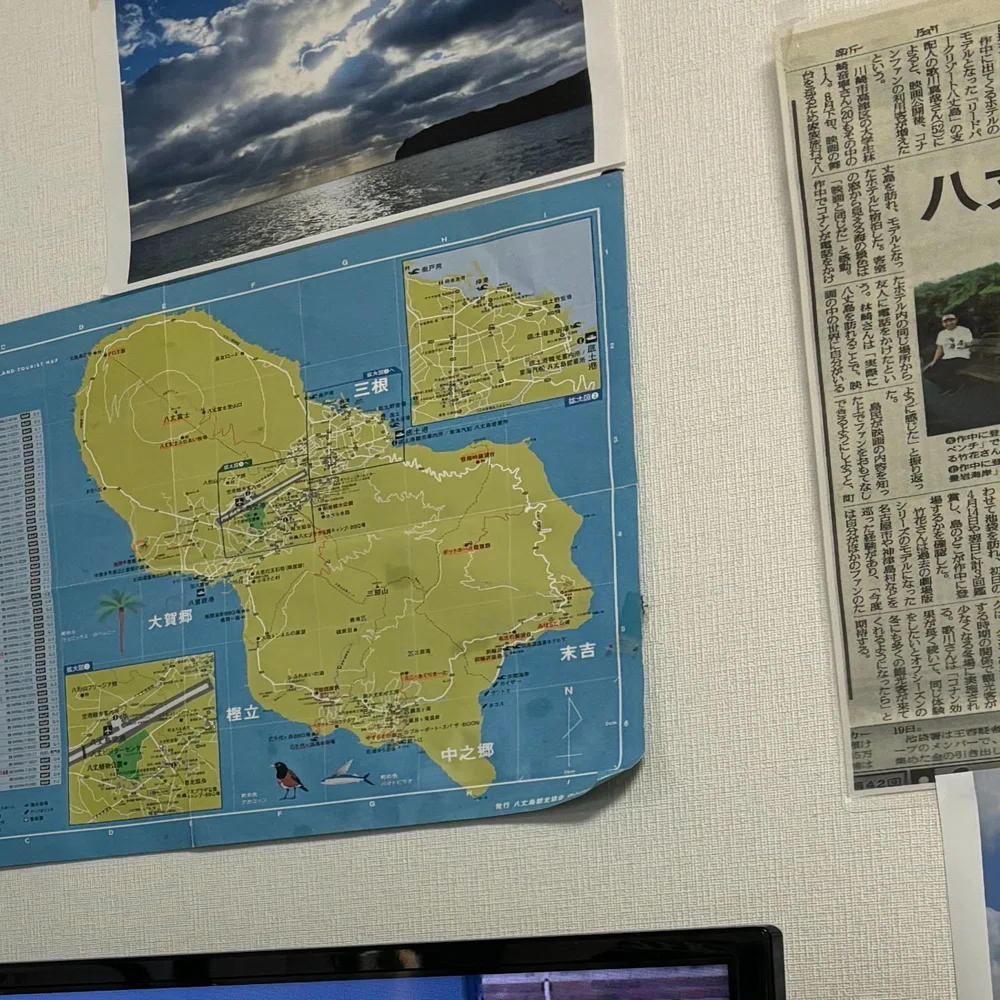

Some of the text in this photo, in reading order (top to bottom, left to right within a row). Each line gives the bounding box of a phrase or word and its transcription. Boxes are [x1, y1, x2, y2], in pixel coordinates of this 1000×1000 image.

[872, 54, 886, 84] という。
[921, 165, 1000, 221] 八
[824, 289, 845, 393] 画の中の世界に自分がいる
[875, 279, 897, 384] 友人に電話をかけたとい
[893, 276, 913, 381] たホテル内の同じ場所から
[354, 377, 389, 398] 三根
[886, 390, 898, 403] た。
[896, 501, 917, 606] シリーズのモデルになった
[148, 608, 193, 630] 大賀郷
[560, 642, 596, 661] 末吉
[855, 619, 870, 659] 期待する。
[564, 687, 574, 695] N
[226, 704, 260, 722] 樫立
[441, 742, 494, 763] 中之郷
